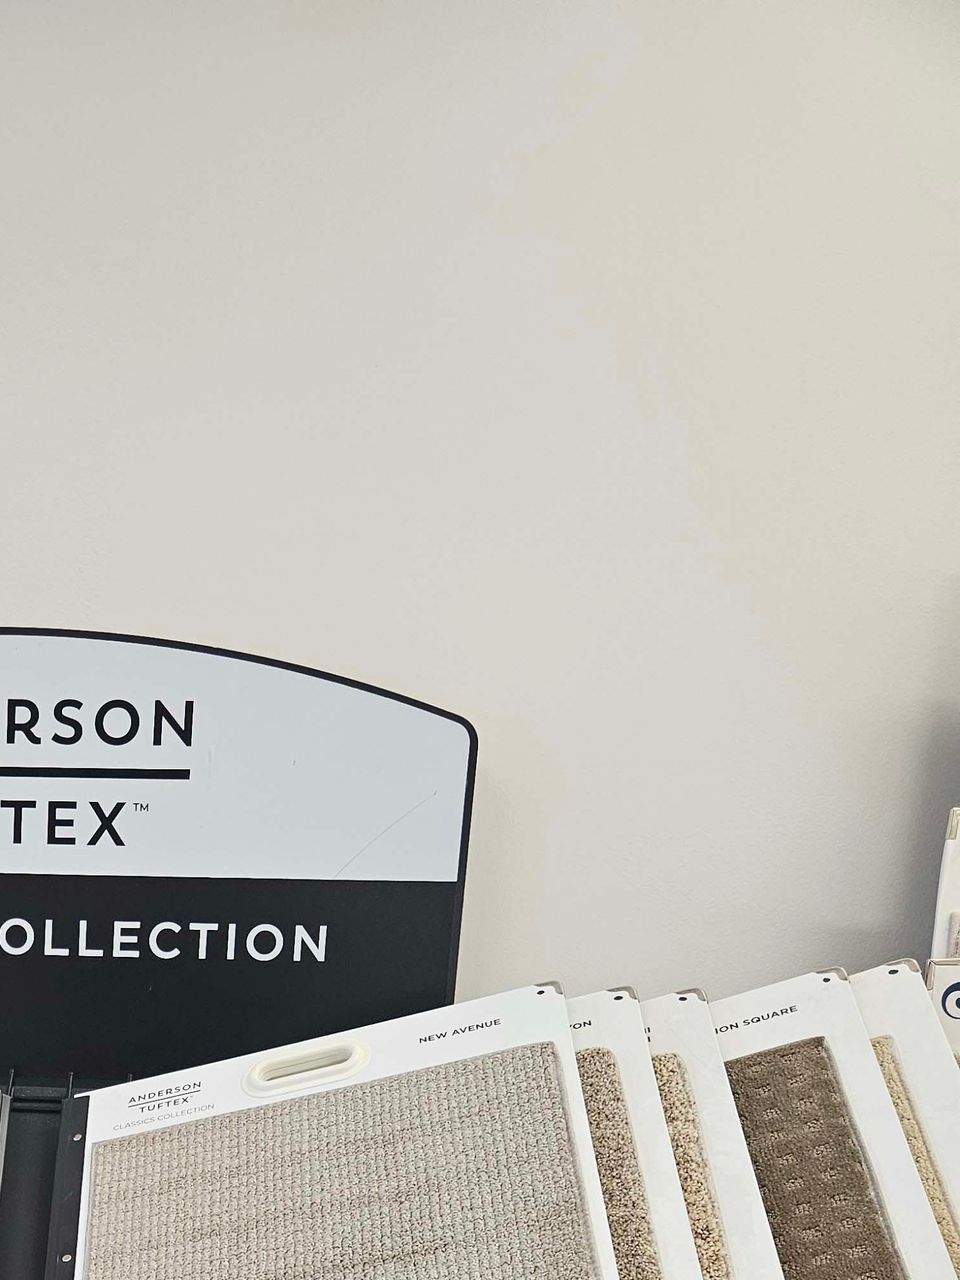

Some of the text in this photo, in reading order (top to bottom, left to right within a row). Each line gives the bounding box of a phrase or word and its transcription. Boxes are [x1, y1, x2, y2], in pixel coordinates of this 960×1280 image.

[419, 1018, 502, 1044] NEW AVENUE
[715, 1005, 798, 1035] ION SQUARE
[128, 1081, 202, 1104] ANDERSON
[113, 1103, 215, 1131] CLASSICS COLLECTION
